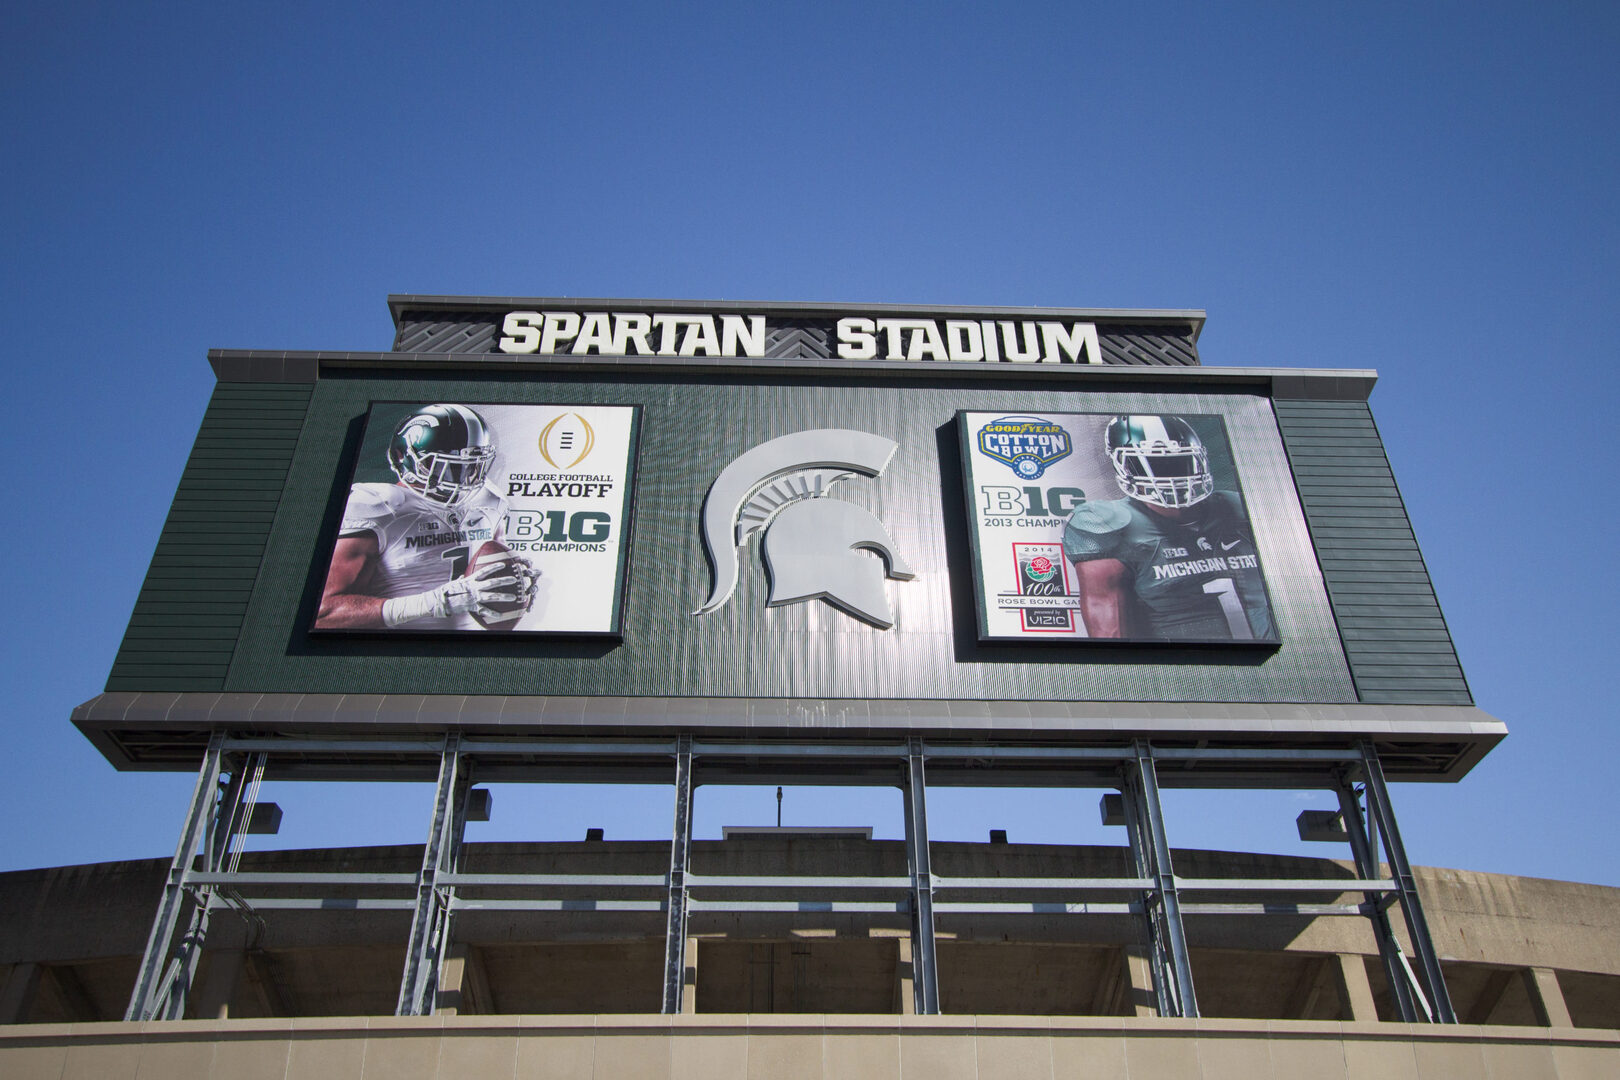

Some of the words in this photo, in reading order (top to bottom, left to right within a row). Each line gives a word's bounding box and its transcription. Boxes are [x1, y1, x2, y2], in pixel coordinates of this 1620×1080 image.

[499, 310, 766, 357] SPARTAN
[837, 317, 1103, 364] STADIUM
[985, 423, 1061, 434] GOODYEAR
[985, 434, 1066, 454] COTTON
[1001, 446, 1051, 458] BOWL
[509, 473, 557, 481] COLLEGE
[559, 474, 613, 482] FOOTBALL
[507, 482, 613, 498] PLAYOFF
[984, 518, 1013, 527] 2013
[404, 531, 468, 549] MICHIGAN
[468, 528, 492, 541] STATE
[531, 543, 606, 552] CHAMPIONS
[1152, 557, 1227, 579] MICHIGAN
